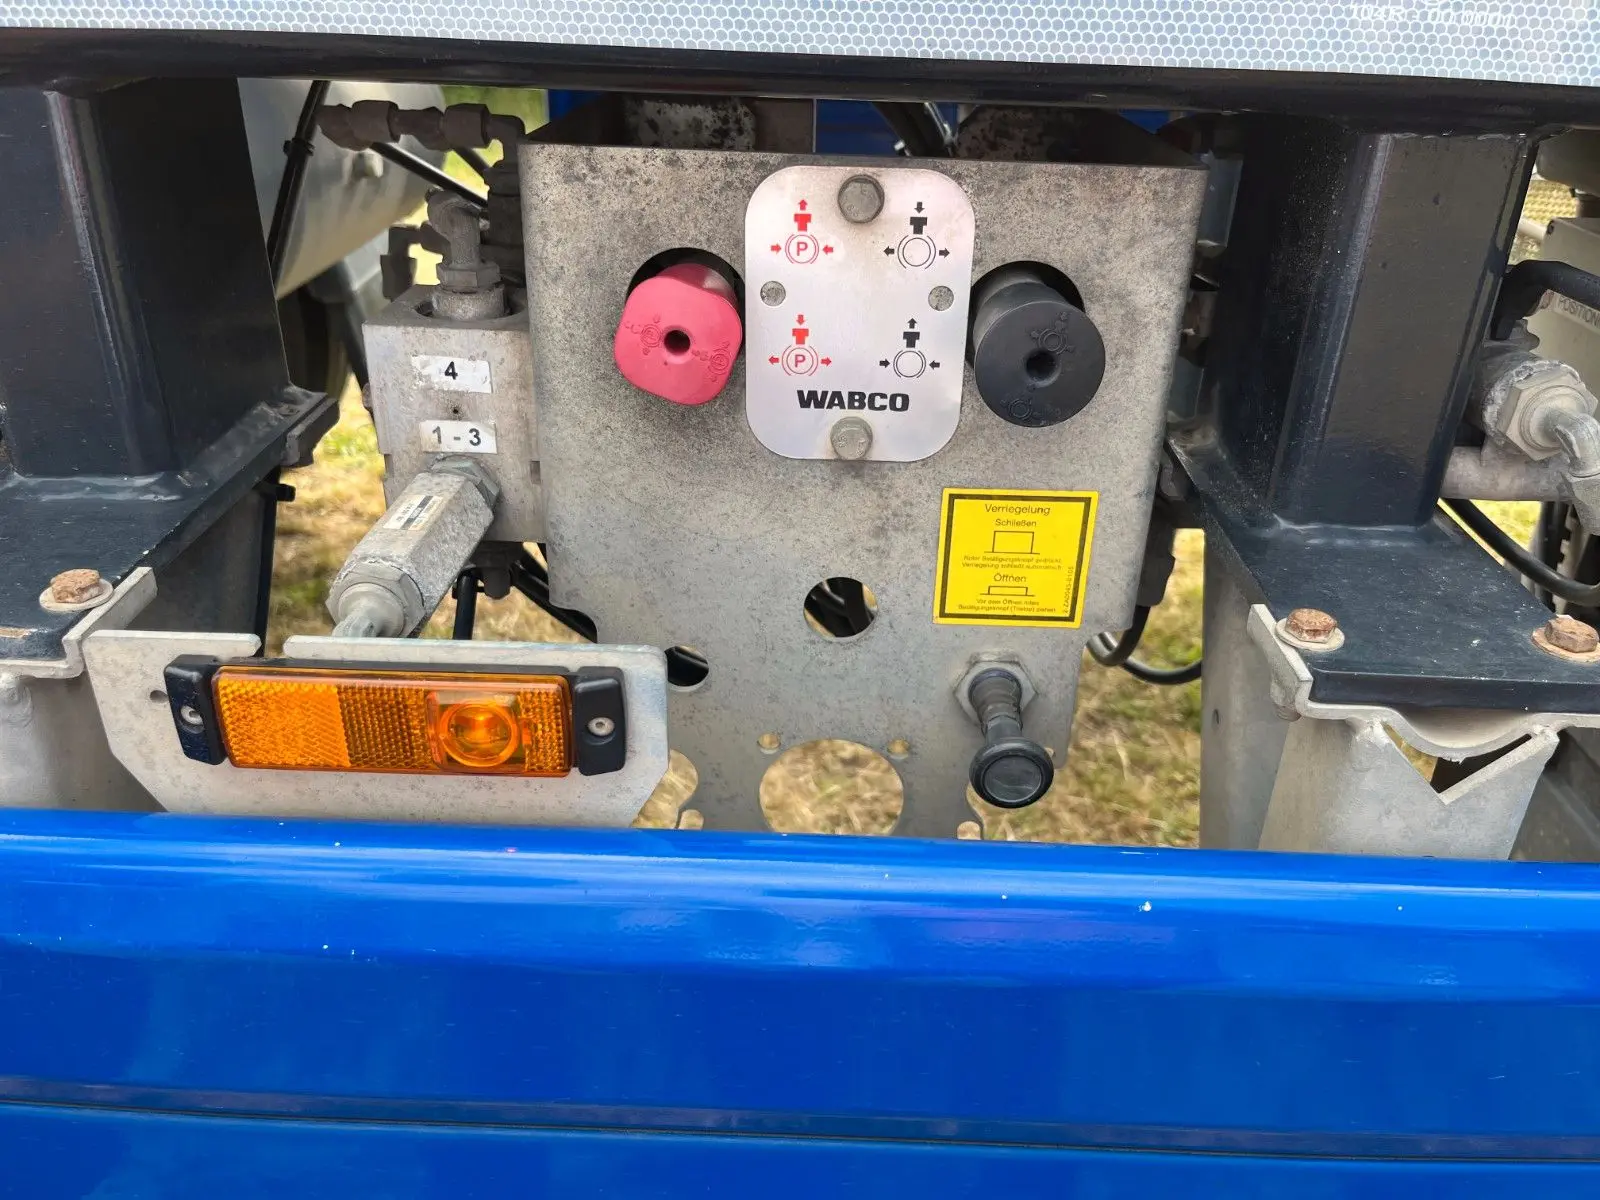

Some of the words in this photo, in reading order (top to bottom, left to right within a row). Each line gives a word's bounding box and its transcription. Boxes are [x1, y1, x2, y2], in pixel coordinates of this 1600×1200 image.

[796, 241, 808, 256] P
[795, 354, 807, 368] P
[444, 361, 458, 380] 4
[796, 390, 910, 412] WABCO
[432, 426, 442, 444] 1
[469, 428, 482, 446] 3
[985, 503, 1051, 516] Verriegelung
[993, 573, 1027, 583] Öffnen
